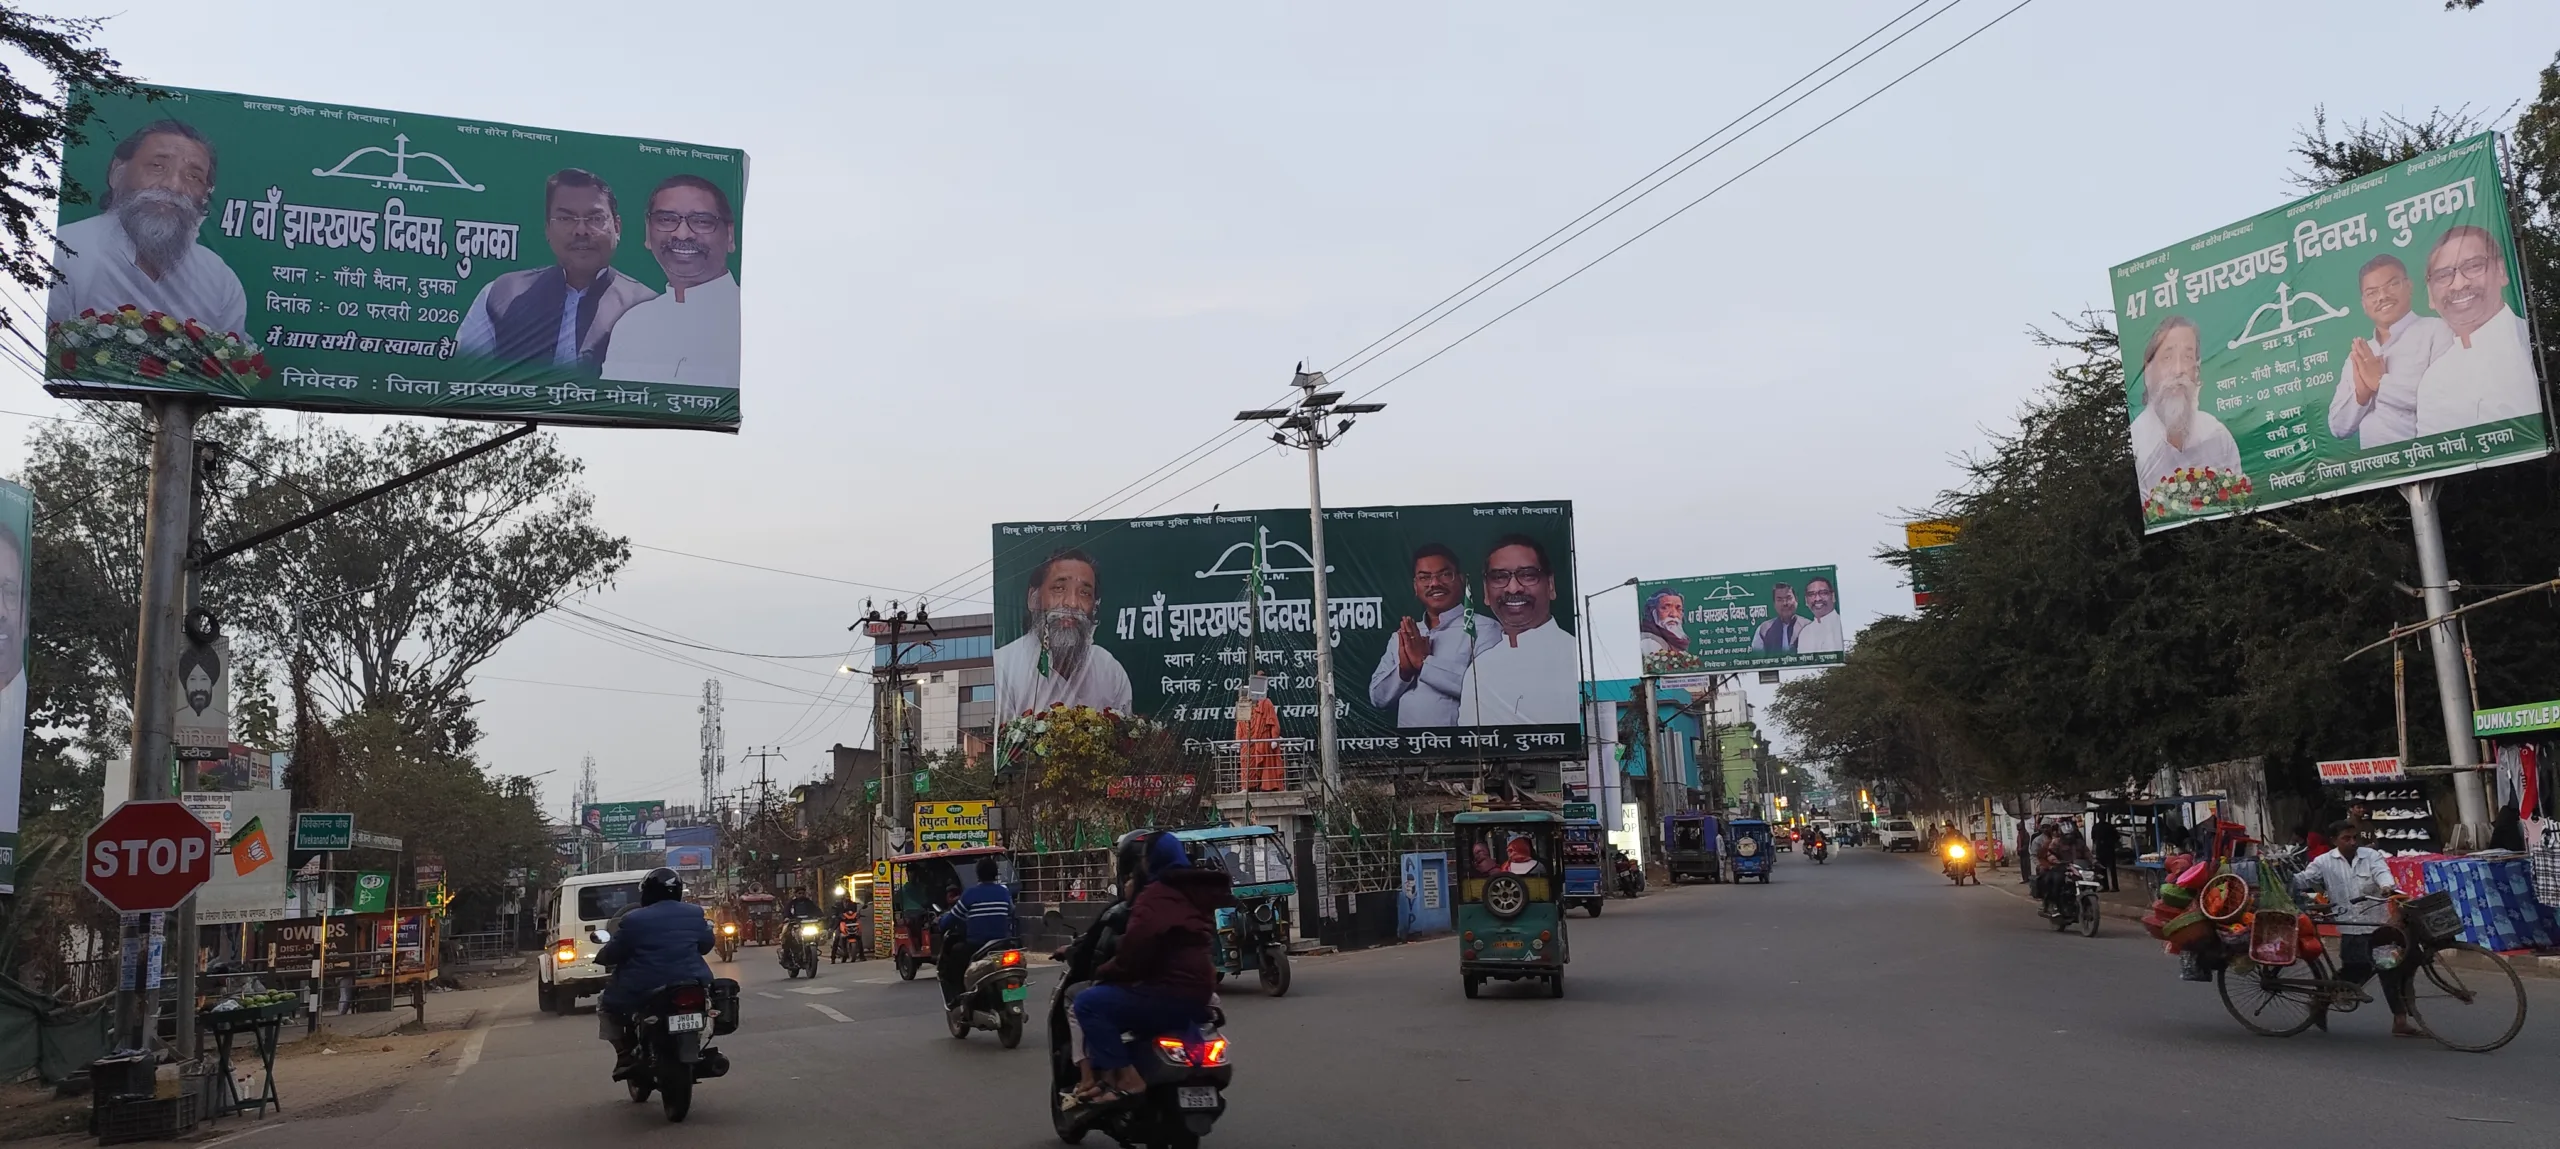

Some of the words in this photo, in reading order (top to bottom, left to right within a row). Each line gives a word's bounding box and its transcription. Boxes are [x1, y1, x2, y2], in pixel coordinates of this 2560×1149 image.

[243, 101, 285, 113] झारखण्ड
[290, 103, 315, 117] मुक्ति
[320, 106, 342, 119] मोर्चा
[457, 124, 480, 135] बसंत
[485, 126, 508, 137] सोरेन
[639, 143, 662, 155] हेमन्त
[665, 145, 688, 158] सोरेन
[371, 183, 429, 193] J.M.M.
[220, 198, 247, 237] 47
[252, 185, 283, 241] वाँ
[283, 203, 379, 254] झारखण्ड
[384, 196, 448, 260] दिवस,
[455, 219, 519, 279] दुमका
[2125, 289, 2147, 320] 47
[2152, 267, 2180, 308] वाँ
[2182, 240, 2289, 304] झारखण्ड
[2293, 212, 2377, 264] दिवस,
[2385, 177, 2476, 247] दुमका
[272, 265, 308, 284] स्थान
[333, 266, 366, 290] गाँधी
[373, 268, 412, 294] मैदान,
[418, 277, 457, 298] दुमका
[266, 291, 311, 314] दिनांक
[337, 302, 359, 318] 02
[366, 301, 411, 322] फरवरी
[418, 308, 459, 324] 2026
[266, 326, 284, 347] में
[286, 331, 318, 349] आप
[321, 330, 356, 351] सभी
[359, 336, 382, 353] का
[384, 339, 437, 357] स्वागत
[2216, 376, 2236, 391] स्थान
[2251, 364, 2271, 381] गाँधी
[2303, 350, 2329, 372] दुमका
[281, 367, 358, 390] निवेदक
[385, 374, 438, 395] जिला
[447, 381, 537, 399] झारखण्ड
[546, 384, 596, 406] मुक्ति
[605, 383, 658, 408] मोर्चा,
[666, 391, 721, 414] दुमका
[2216, 394, 2242, 412] दिनांक
[2256, 389, 2271, 401] 02
[2273, 378, 2302, 396] फरवरी
[2305, 371, 2334, 388] 2026
[2265, 410, 2275, 423] में
[2280, 406, 2302, 420] आप
[2265, 427, 2288, 442] सभी
[2292, 422, 2308, 435] का
[2263, 444, 2295, 460] स्वागत
[2268, 470, 2306, 491] निवेदक
[2317, 462, 2347, 481] जिला
[2350, 452, 2400, 474] झारखण्ड
[2402, 442, 2435, 469] मुक्ति
[2477, 428, 2515, 454] दुमका
[1333, 509, 1354, 520] सोरेन
[1473, 506, 1494, 517] हेमन्त
[1498, 506, 1518, 516] सोरेन
[1002, 524, 1021, 537] शिबू
[1023, 523, 1045, 534] सोरेन
[1130, 520, 1164, 529] झारखण्ड
[1168, 517, 1189, 528] मुक्ति
[1193, 516, 1212, 526] मोर्चा
[1116, 606, 1137, 641] 47
[1141, 590, 1166, 639] वाँ
[1168, 601, 1251, 642] झारखण्ड
[1327, 596, 1383, 648] दुमका
[1749, 604, 1768, 625] दुमका
[1164, 653, 1195, 667] स्थान
[1217, 647, 1247, 667] गाँधी
[1161, 675, 1201, 695] दिनांक
[1224, 678, 1242, 691] 02
[1173, 704, 1188, 721] में
[1190, 706, 1219, 720] आप
[1283, 703, 1318, 718] स्वाग
[2476, 711, 2513, 731] DUMKA
[2515, 706, 2550, 727] STYLE
[181, 747, 212, 758] स्टील
[1337, 735, 1399, 752] ारखण्ड
[1407, 731, 1452, 754] मुक्ति
[1516, 732, 1566, 752] दुमका
[2321, 763, 2349, 777] DUMKA
[2349, 761, 2371, 775] SHOE
[2372, 759, 2397, 774] POINT
[301, 817, 334, 829] विवेकानन्द
[335, 816, 349, 828] चौक
[299, 833, 329, 845] Vivekanand
[330, 833, 349, 845] Chowk
[92, 837, 205, 878] STOP
[677, 1014, 695, 1022] JH04
